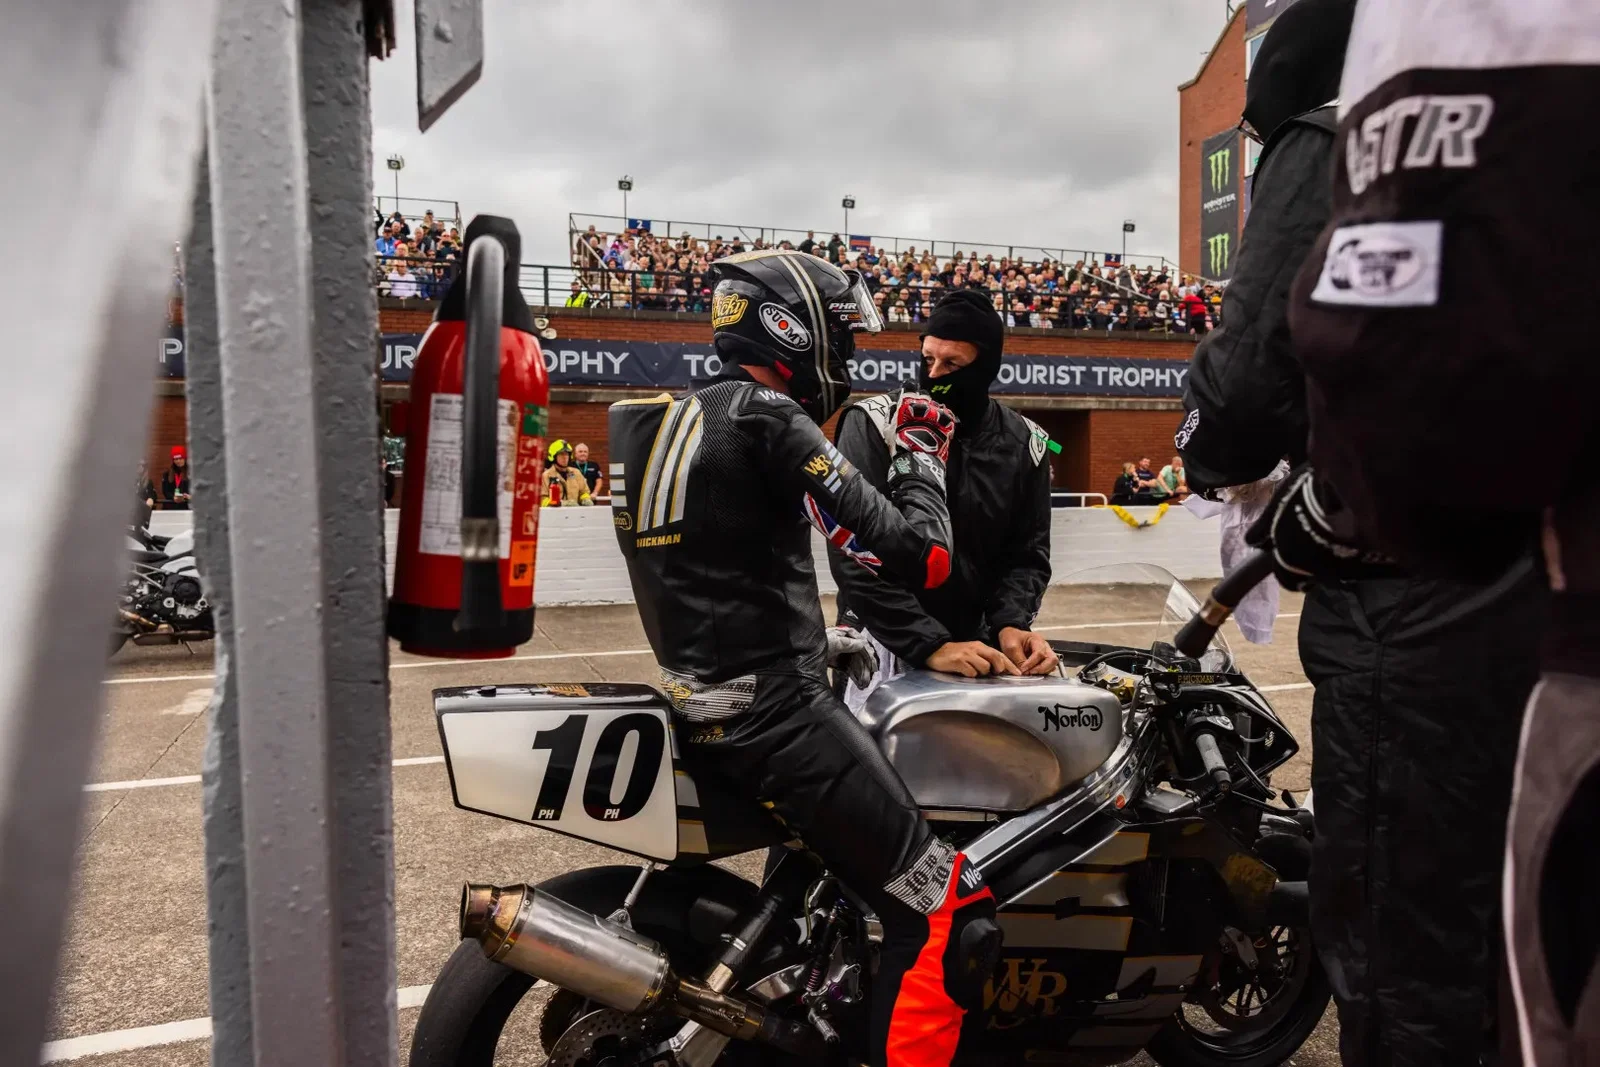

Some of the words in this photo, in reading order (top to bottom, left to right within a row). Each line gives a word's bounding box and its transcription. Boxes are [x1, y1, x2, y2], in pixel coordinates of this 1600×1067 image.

[636, 220, 644, 229] 2
[828, 302, 857, 310] PHR
[1092, 366, 1188, 387] TROPHY
[637, 533, 681, 548] HICKMAN
[1037, 703, 1103, 731] Norton
[531, 713, 665, 822] 10
[538, 809, 555, 820] PH
[604, 808, 620, 819] PH
